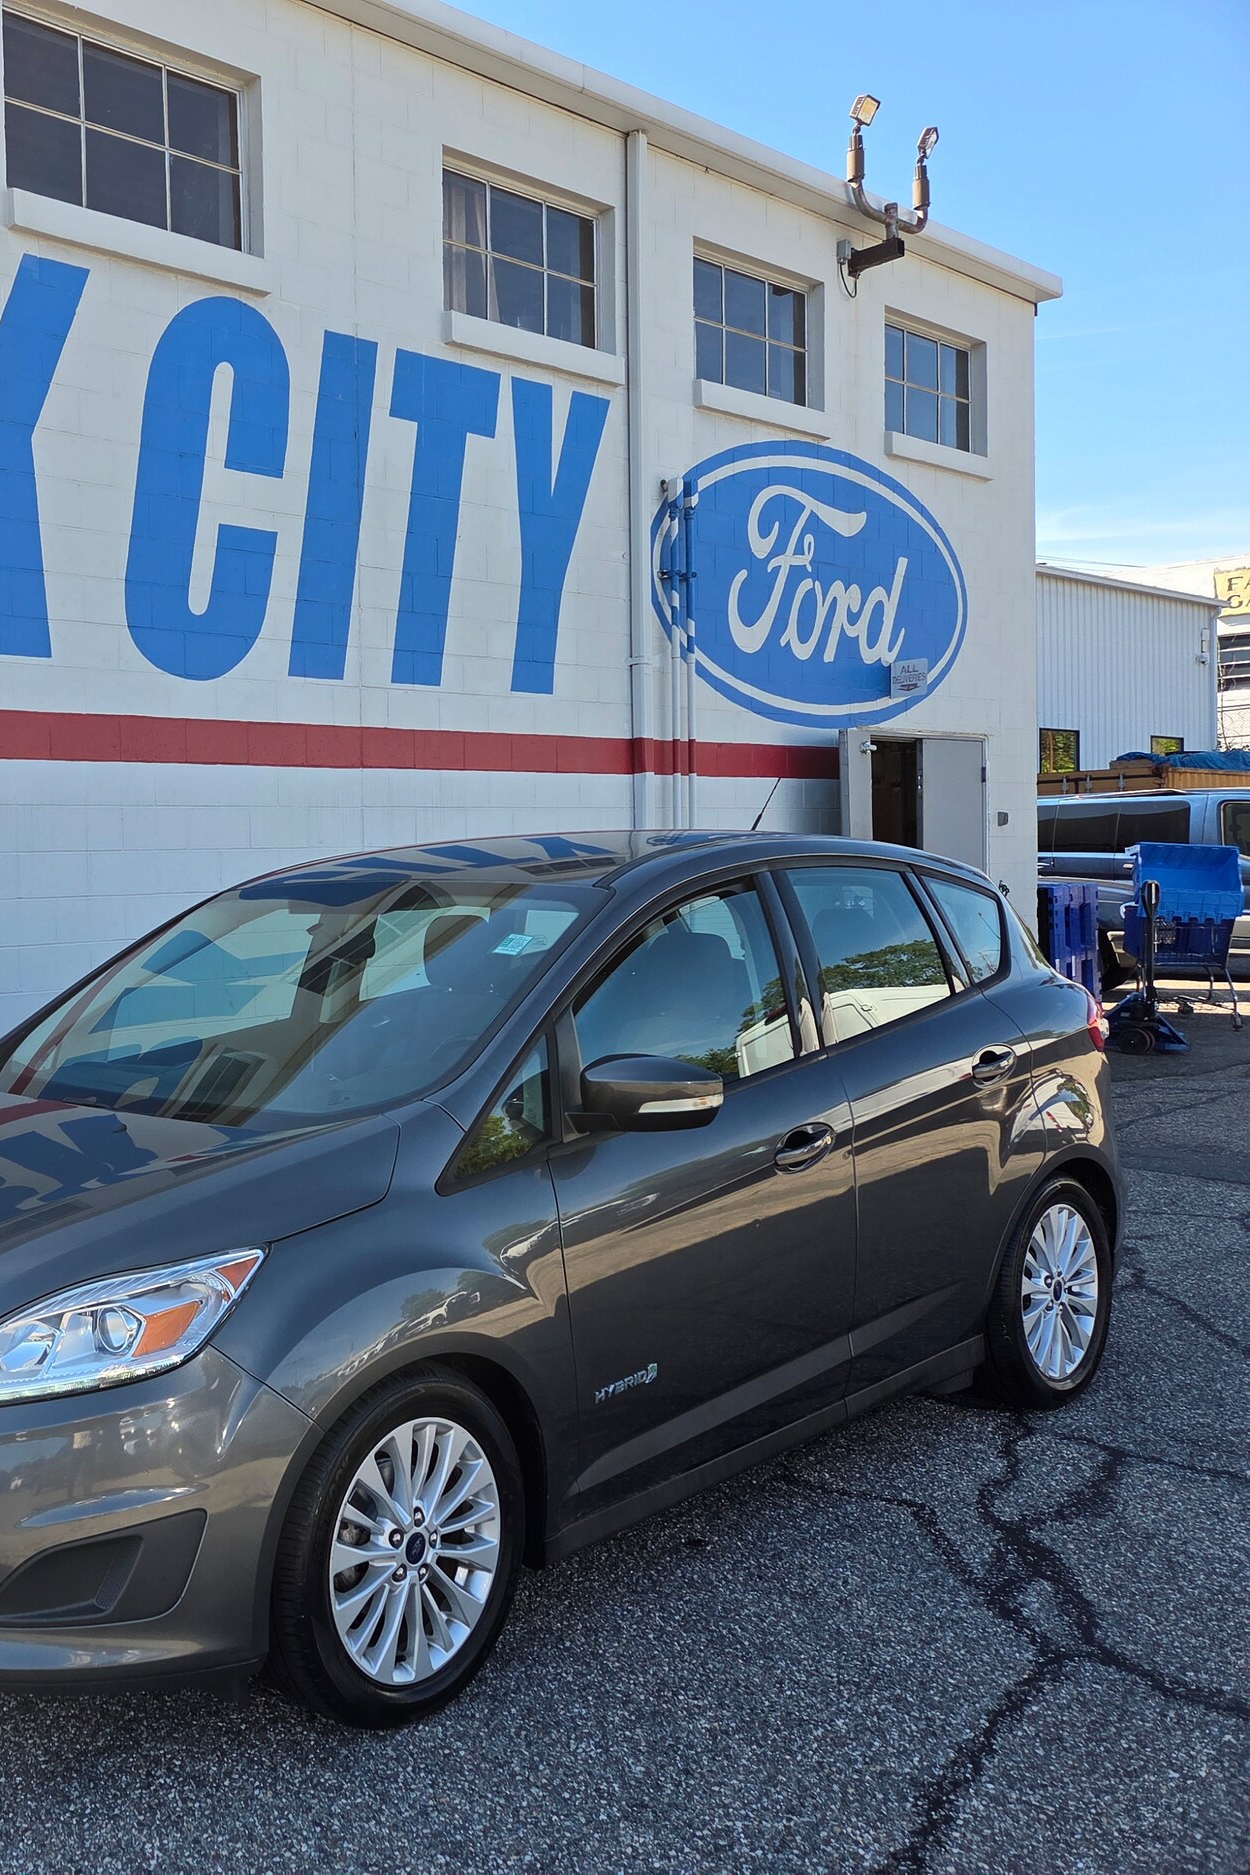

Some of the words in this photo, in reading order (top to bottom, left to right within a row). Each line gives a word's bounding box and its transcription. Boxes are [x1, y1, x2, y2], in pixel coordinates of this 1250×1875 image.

[124, 296, 609, 695] CITY
[728, 485, 908, 666] Ford
[892, 672, 927, 684] DELIVERIES
[900, 664, 919, 674] ALL
[594, 1369, 647, 1404] HYBRID
